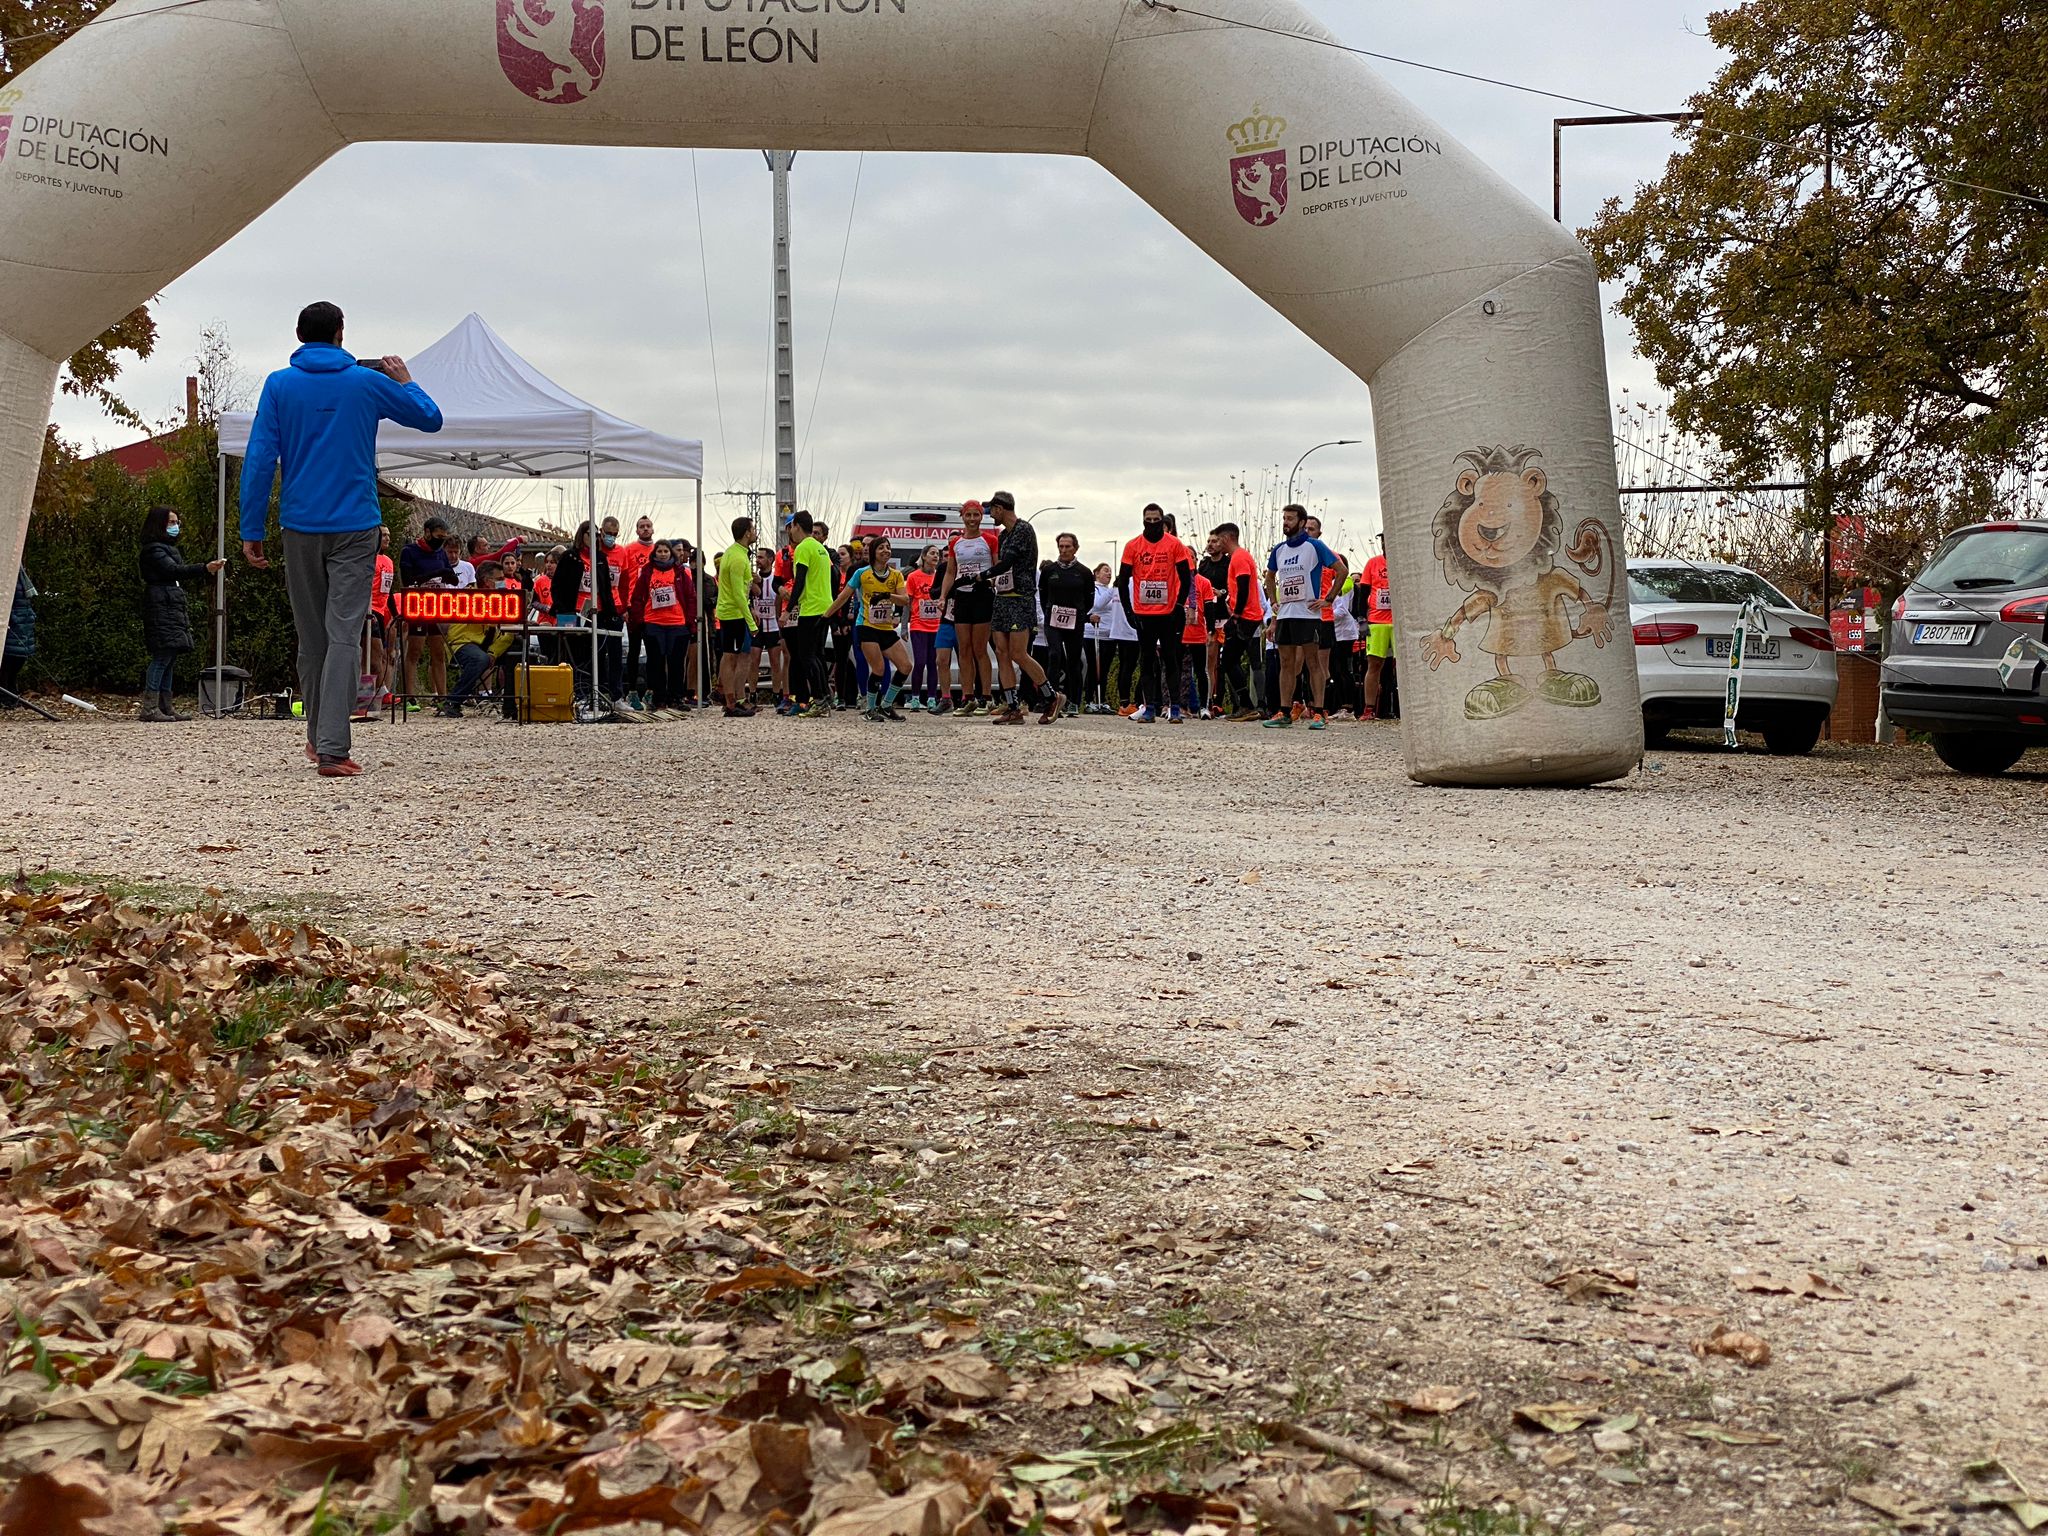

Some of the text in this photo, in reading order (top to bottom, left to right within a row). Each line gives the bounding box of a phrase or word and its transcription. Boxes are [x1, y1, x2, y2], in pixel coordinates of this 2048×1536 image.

[631, 16, 818, 63] DE LEÓN
[22, 115, 168, 157] DIPUTACIÓN
[1300, 134, 1442, 165] DIPUTACIÓN
[18, 139, 119, 175] DE LEÓN
[1300, 155, 1402, 192] DE LEÓN
[15, 171, 123, 199] DEPORTES Y JUVENTUD
[1302, 189, 1408, 216] DEPORTES Y JUVENTUD
[656, 594, 670, 602] 463
[1145, 589, 1161, 598] 448
[1284, 586, 1299, 596] 445
[759, 606, 770, 614] 441
[874, 609, 887, 619] 472
[924, 606, 937, 614] 444
[1057, 614, 1069, 623] 477
[1922, 626, 1973, 640] 2807 HRW
[1716, 640, 1748, 655] 892
[1752, 642, 1777, 655] HJZ
